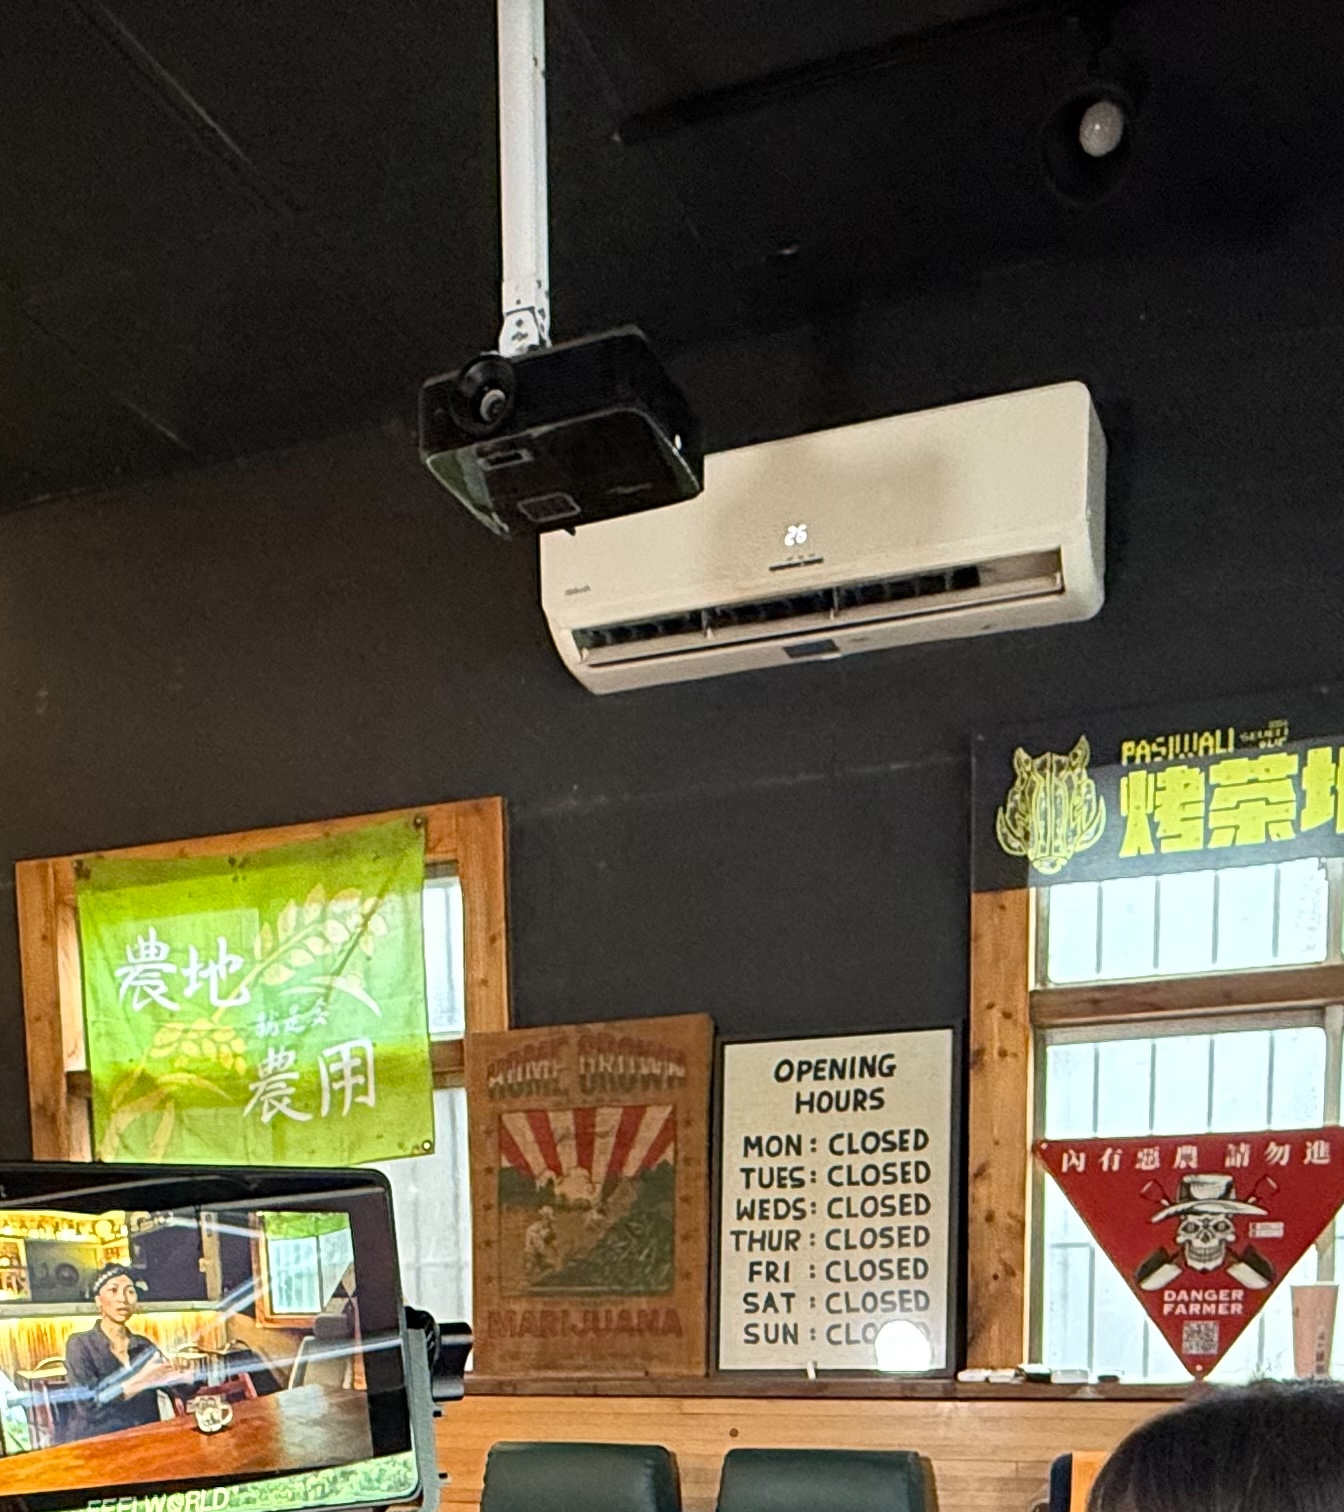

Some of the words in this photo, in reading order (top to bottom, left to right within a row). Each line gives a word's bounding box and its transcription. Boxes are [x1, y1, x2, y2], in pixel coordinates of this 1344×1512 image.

[784, 523, 808, 547] 26
[113, 925, 252, 1014] 農地
[243, 1034, 376, 1125] 農用
[773, 1052, 897, 1083] OPENING
[794, 1087, 886, 1114] HOURS
[828, 1128, 930, 1156] CLOSED
[826, 1160, 931, 1188] CLOSED
[826, 1193, 931, 1220] CLOSED
[824, 1225, 931, 1252] CLOSED
[824, 1257, 929, 1283] CLOSED
[825, 1289, 931, 1315] CLOSED
[1162, 1302, 1244, 1316] FARMER
[1163, 1289, 1245, 1302] DANGER
[486, 1307, 684, 1339] MARIJUANA
